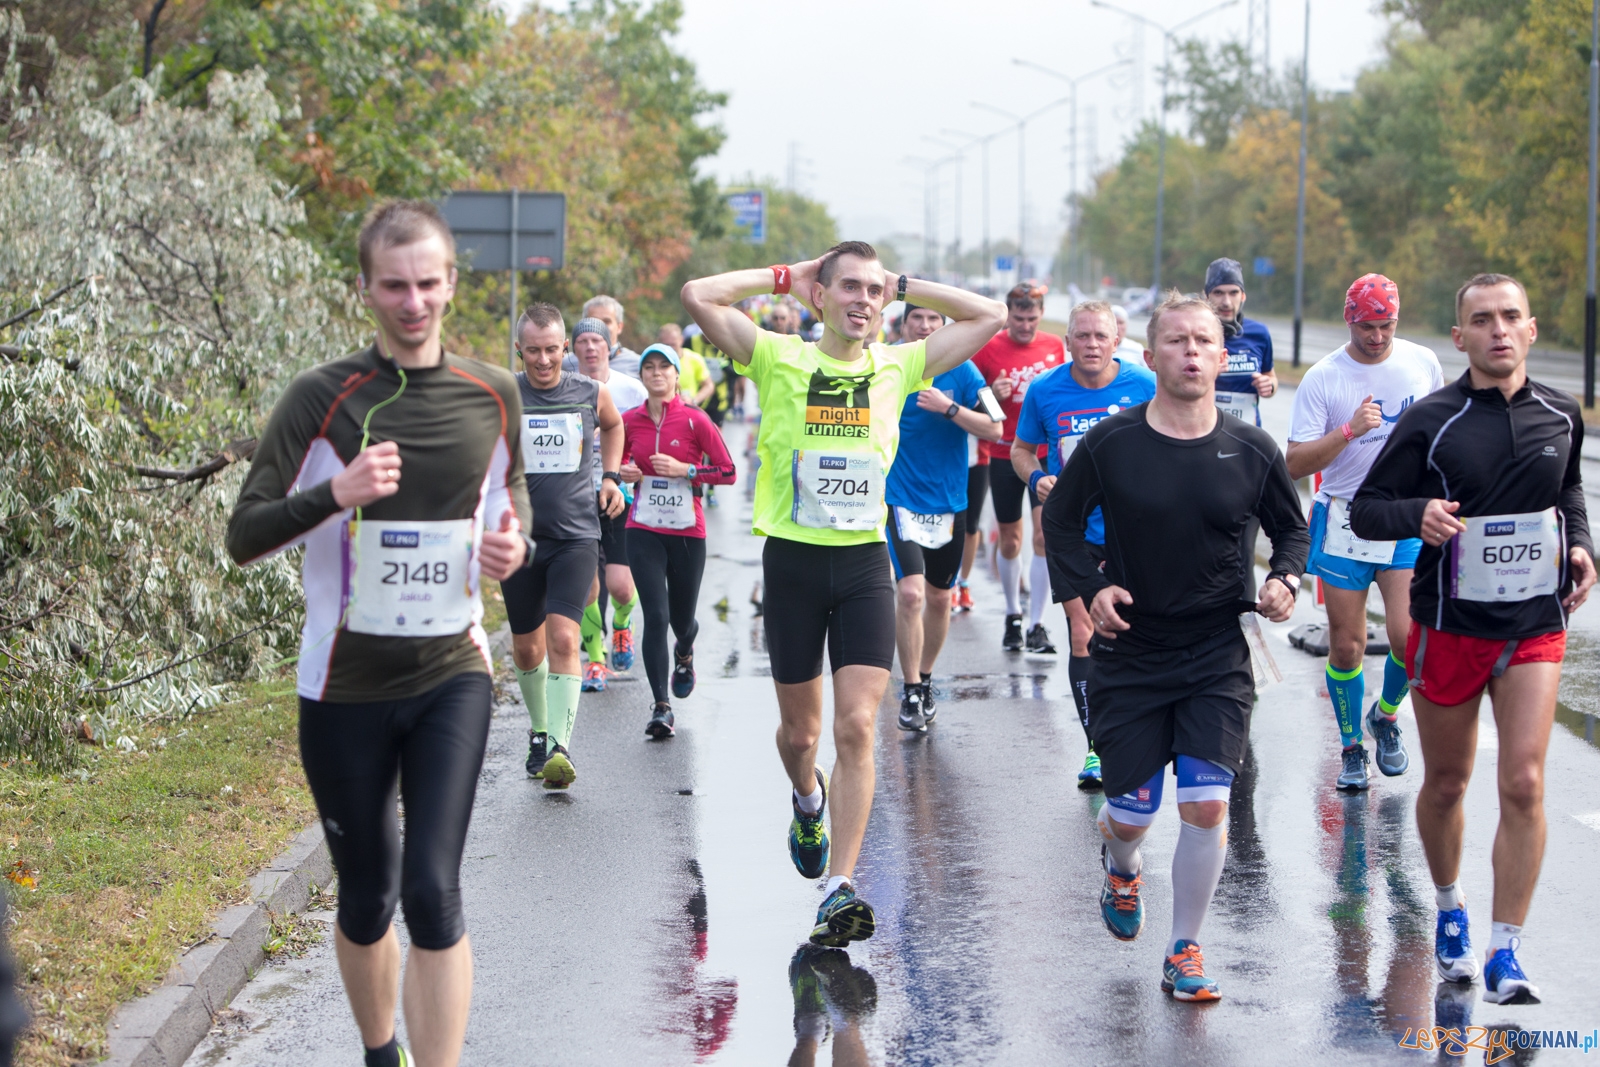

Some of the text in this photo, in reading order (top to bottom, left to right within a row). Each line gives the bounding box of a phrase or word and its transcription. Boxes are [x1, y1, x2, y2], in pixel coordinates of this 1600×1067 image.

[820, 408, 860, 423] night
[805, 423, 869, 437] runners
[533, 434, 564, 447] 470
[816, 478, 869, 495] 2704
[648, 494, 683, 507] 5042
[910, 511, 943, 526] 2042
[1487, 525, 1514, 533] 17.PKO
[1482, 542, 1542, 564] 6076
[381, 561, 449, 585] 2148
[1494, 568, 1532, 576] Tomasz
[398, 591, 432, 602] Jakub
